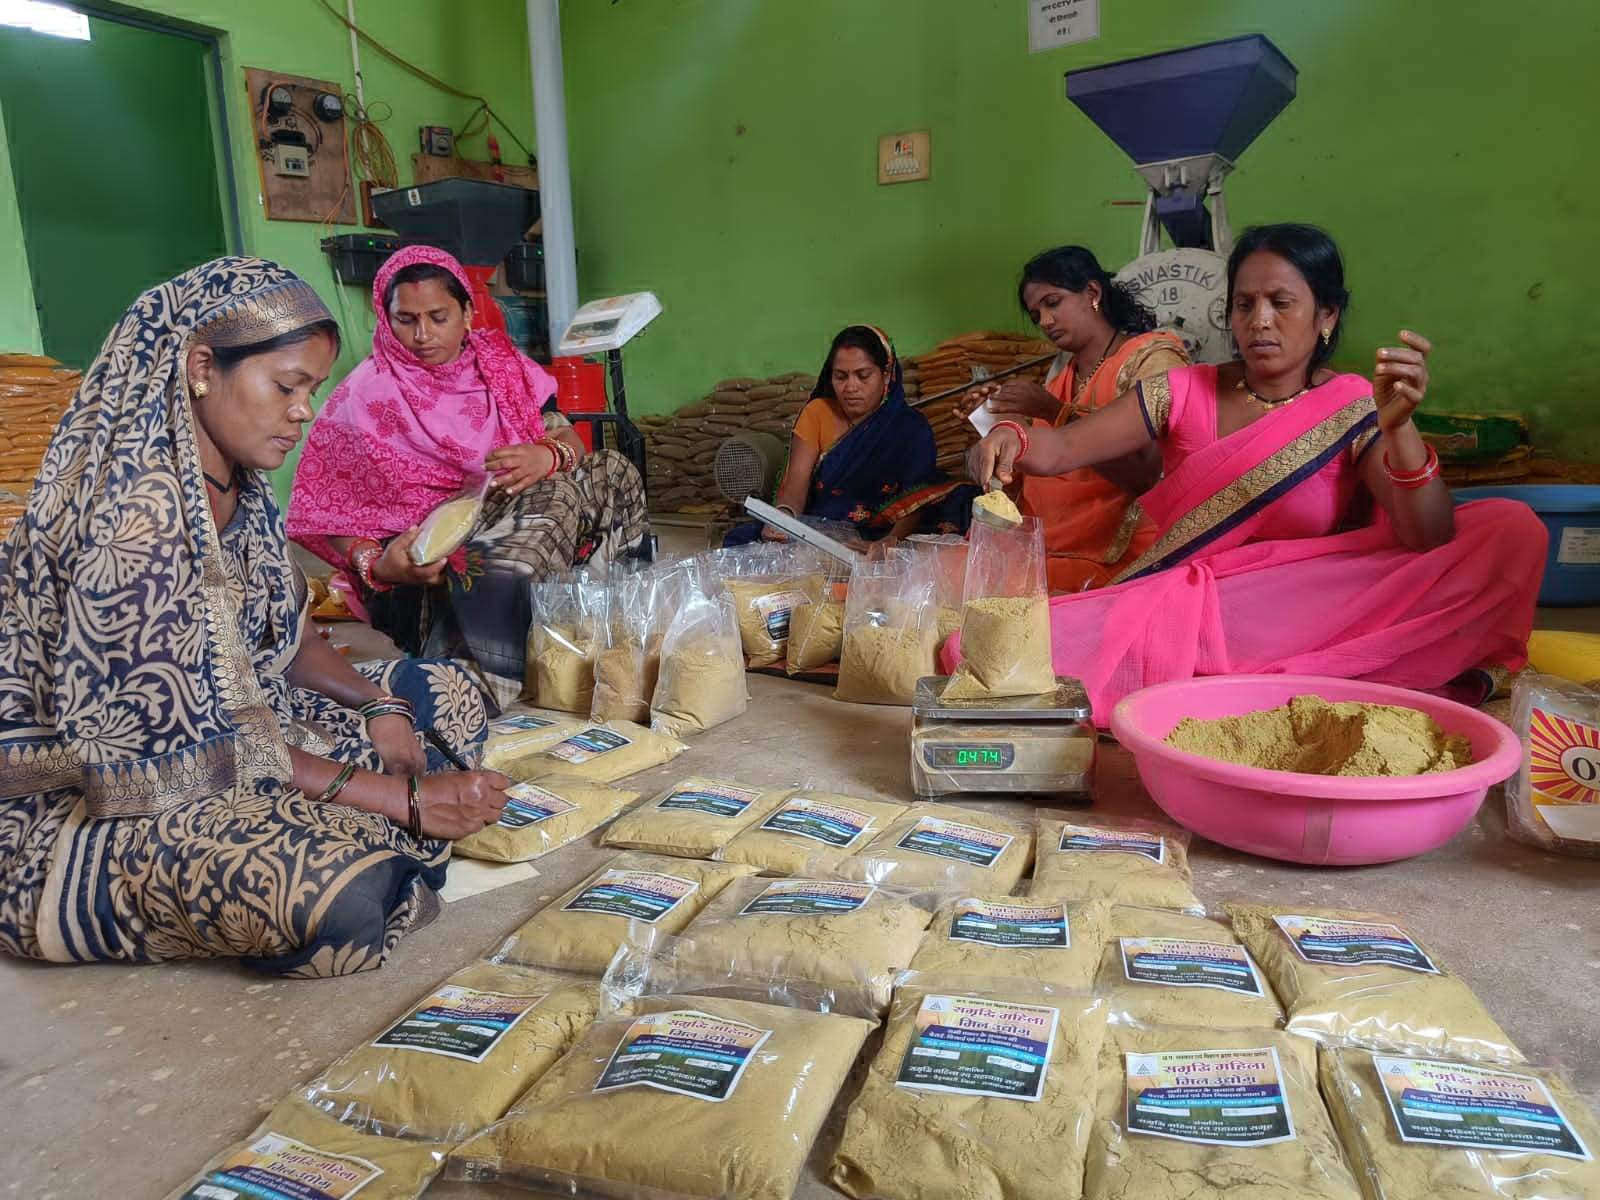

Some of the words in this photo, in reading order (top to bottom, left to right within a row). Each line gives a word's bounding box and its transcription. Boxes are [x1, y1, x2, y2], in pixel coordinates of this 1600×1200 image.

[1052, 0, 1071, 9] CCTV
[1127, 263, 1216, 293] SWASTIK
[1161, 286, 1179, 301] 18
[958, 750, 998, 764] 0474
